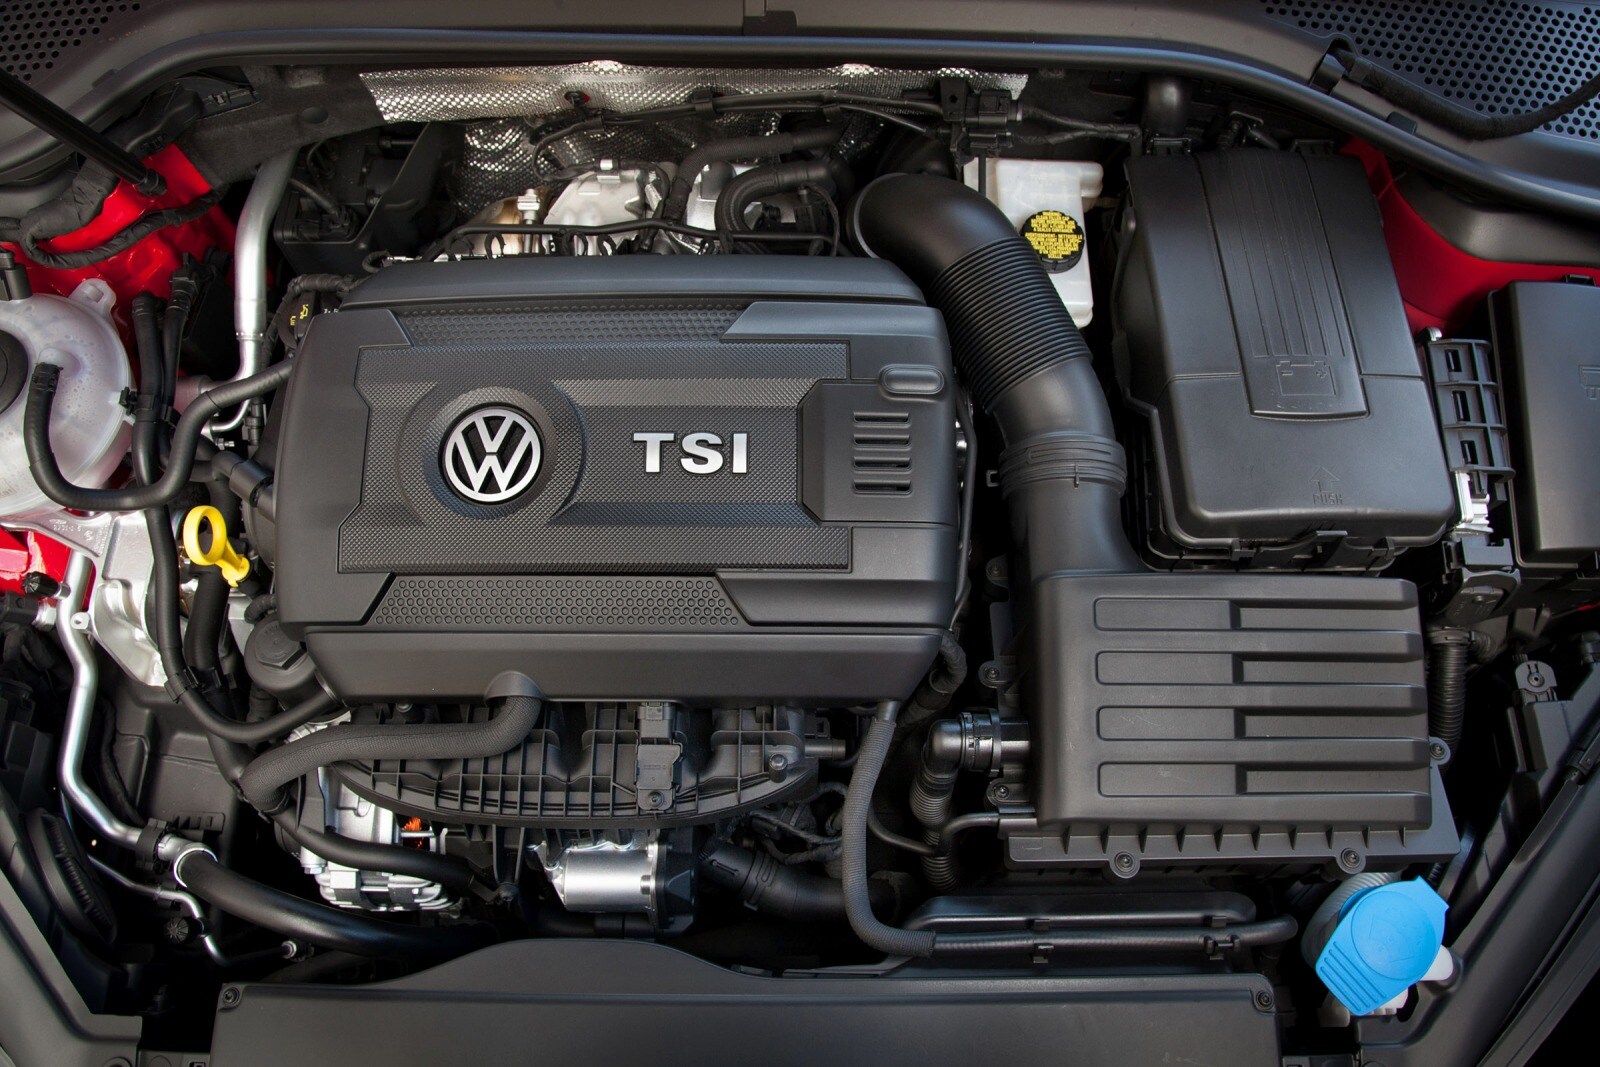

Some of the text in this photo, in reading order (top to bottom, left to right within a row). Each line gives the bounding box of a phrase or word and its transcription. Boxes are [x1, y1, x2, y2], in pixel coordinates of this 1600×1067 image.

[445, 408, 541, 502] VW
[633, 432, 748, 475] TSI
[1313, 494, 1343, 505] PUSH
